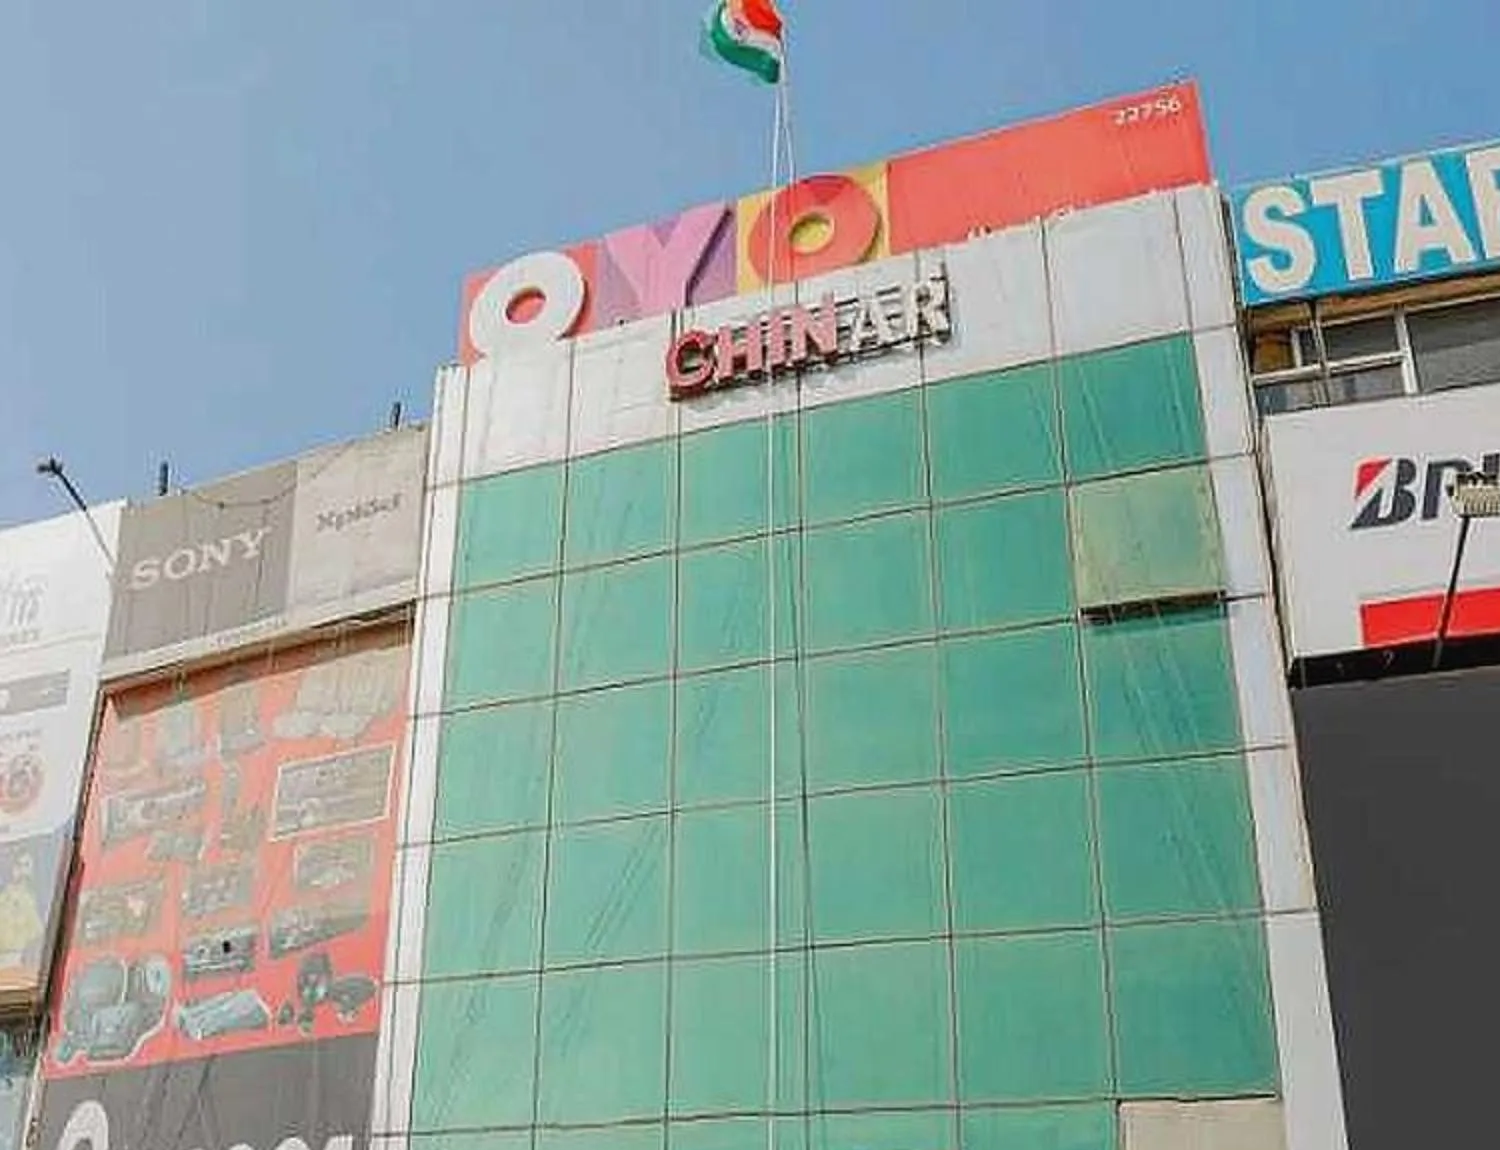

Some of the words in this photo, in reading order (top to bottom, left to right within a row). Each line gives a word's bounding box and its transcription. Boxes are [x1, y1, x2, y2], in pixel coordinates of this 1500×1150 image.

[468, 175, 882, 360] OYO
[666, 268, 950, 399] CHINAR
[127, 525, 275, 591] SONY
